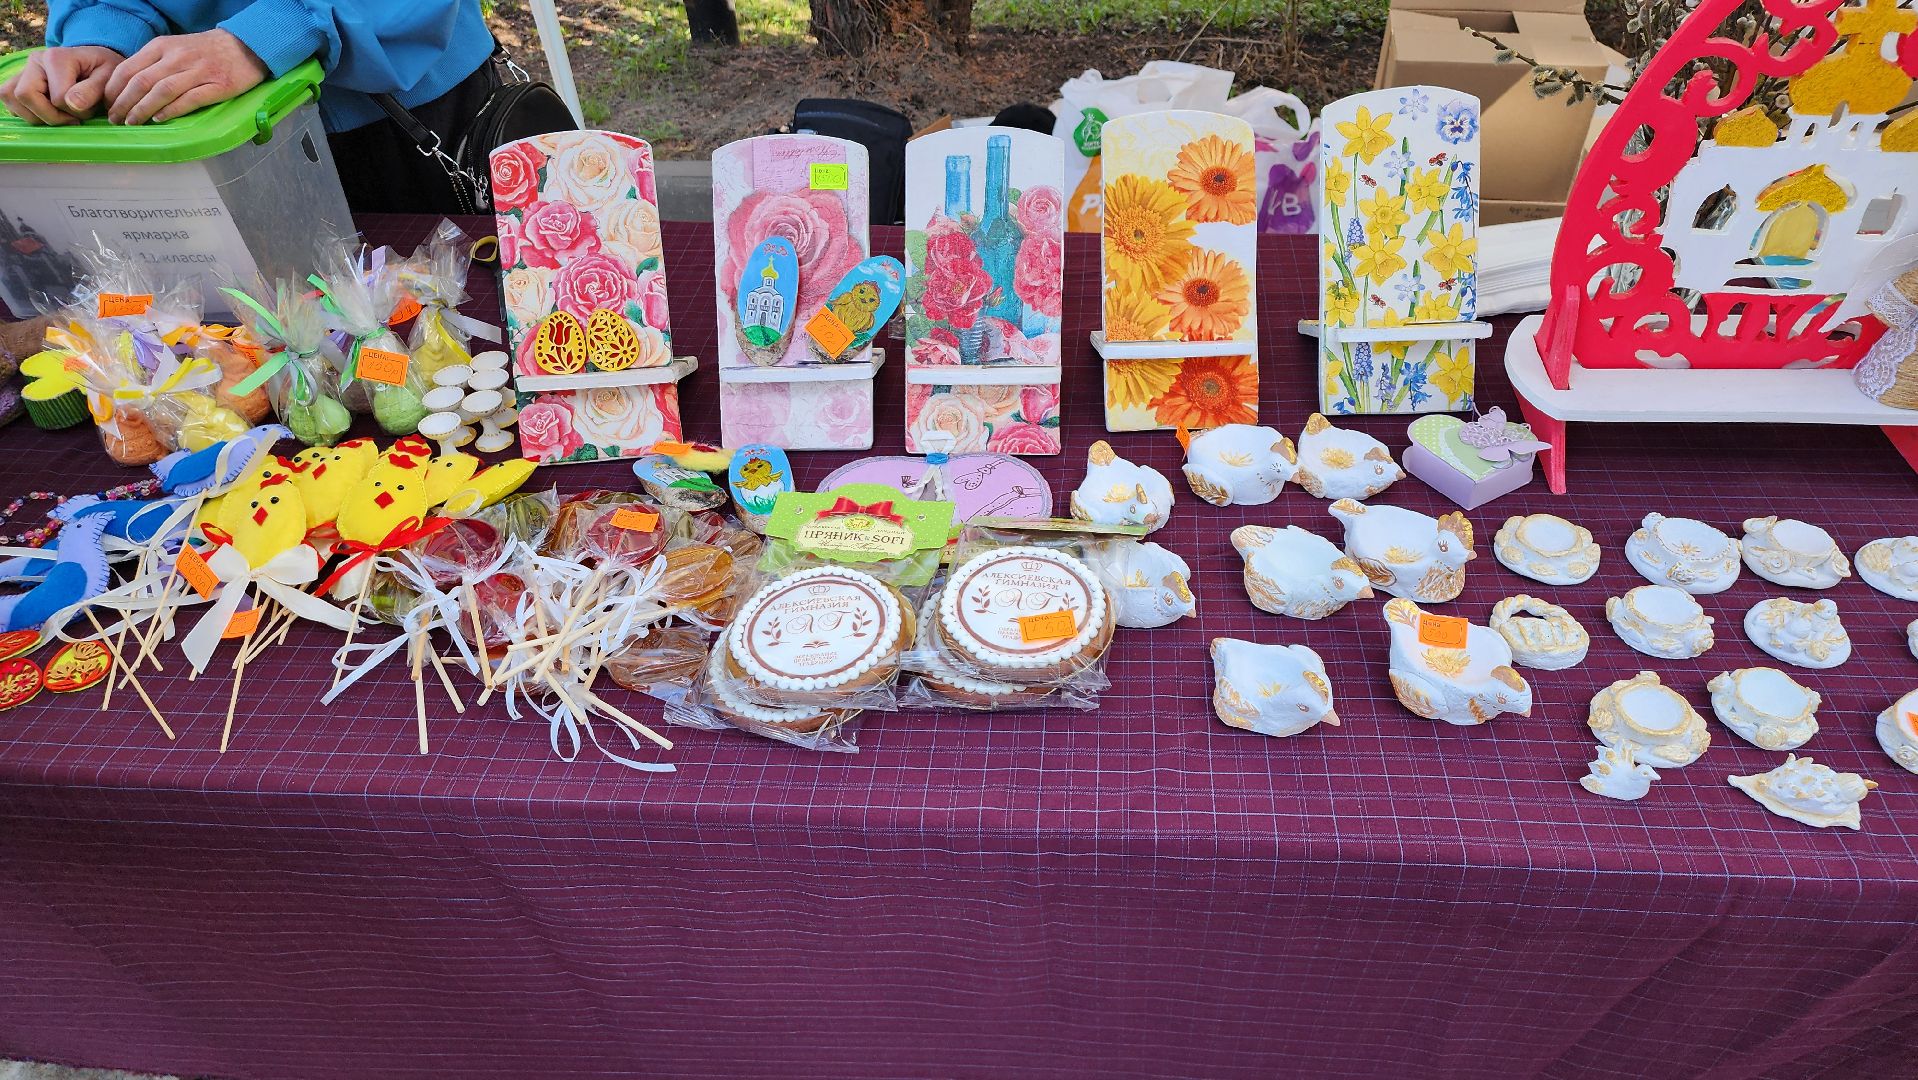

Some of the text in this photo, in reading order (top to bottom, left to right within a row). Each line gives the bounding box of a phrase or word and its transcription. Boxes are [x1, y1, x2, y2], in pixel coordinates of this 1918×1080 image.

[67, 205, 222, 222] Благотворительная
[122, 230, 190, 243] ярмарка
[163, 252, 217, 264] классы
[804, 530, 864, 542] ПРЯНИК
[871, 535, 905, 545] SOFI
[982, 573, 1071, 586] АЛЕКСИЕВСКАЯ
[995, 580, 1059, 591] ГИМНАЗИЯ
[770, 595, 861, 611] АЛЕКСИЕВСКАЯ
[785, 602, 849, 614] ГИМНАЗИЯ
